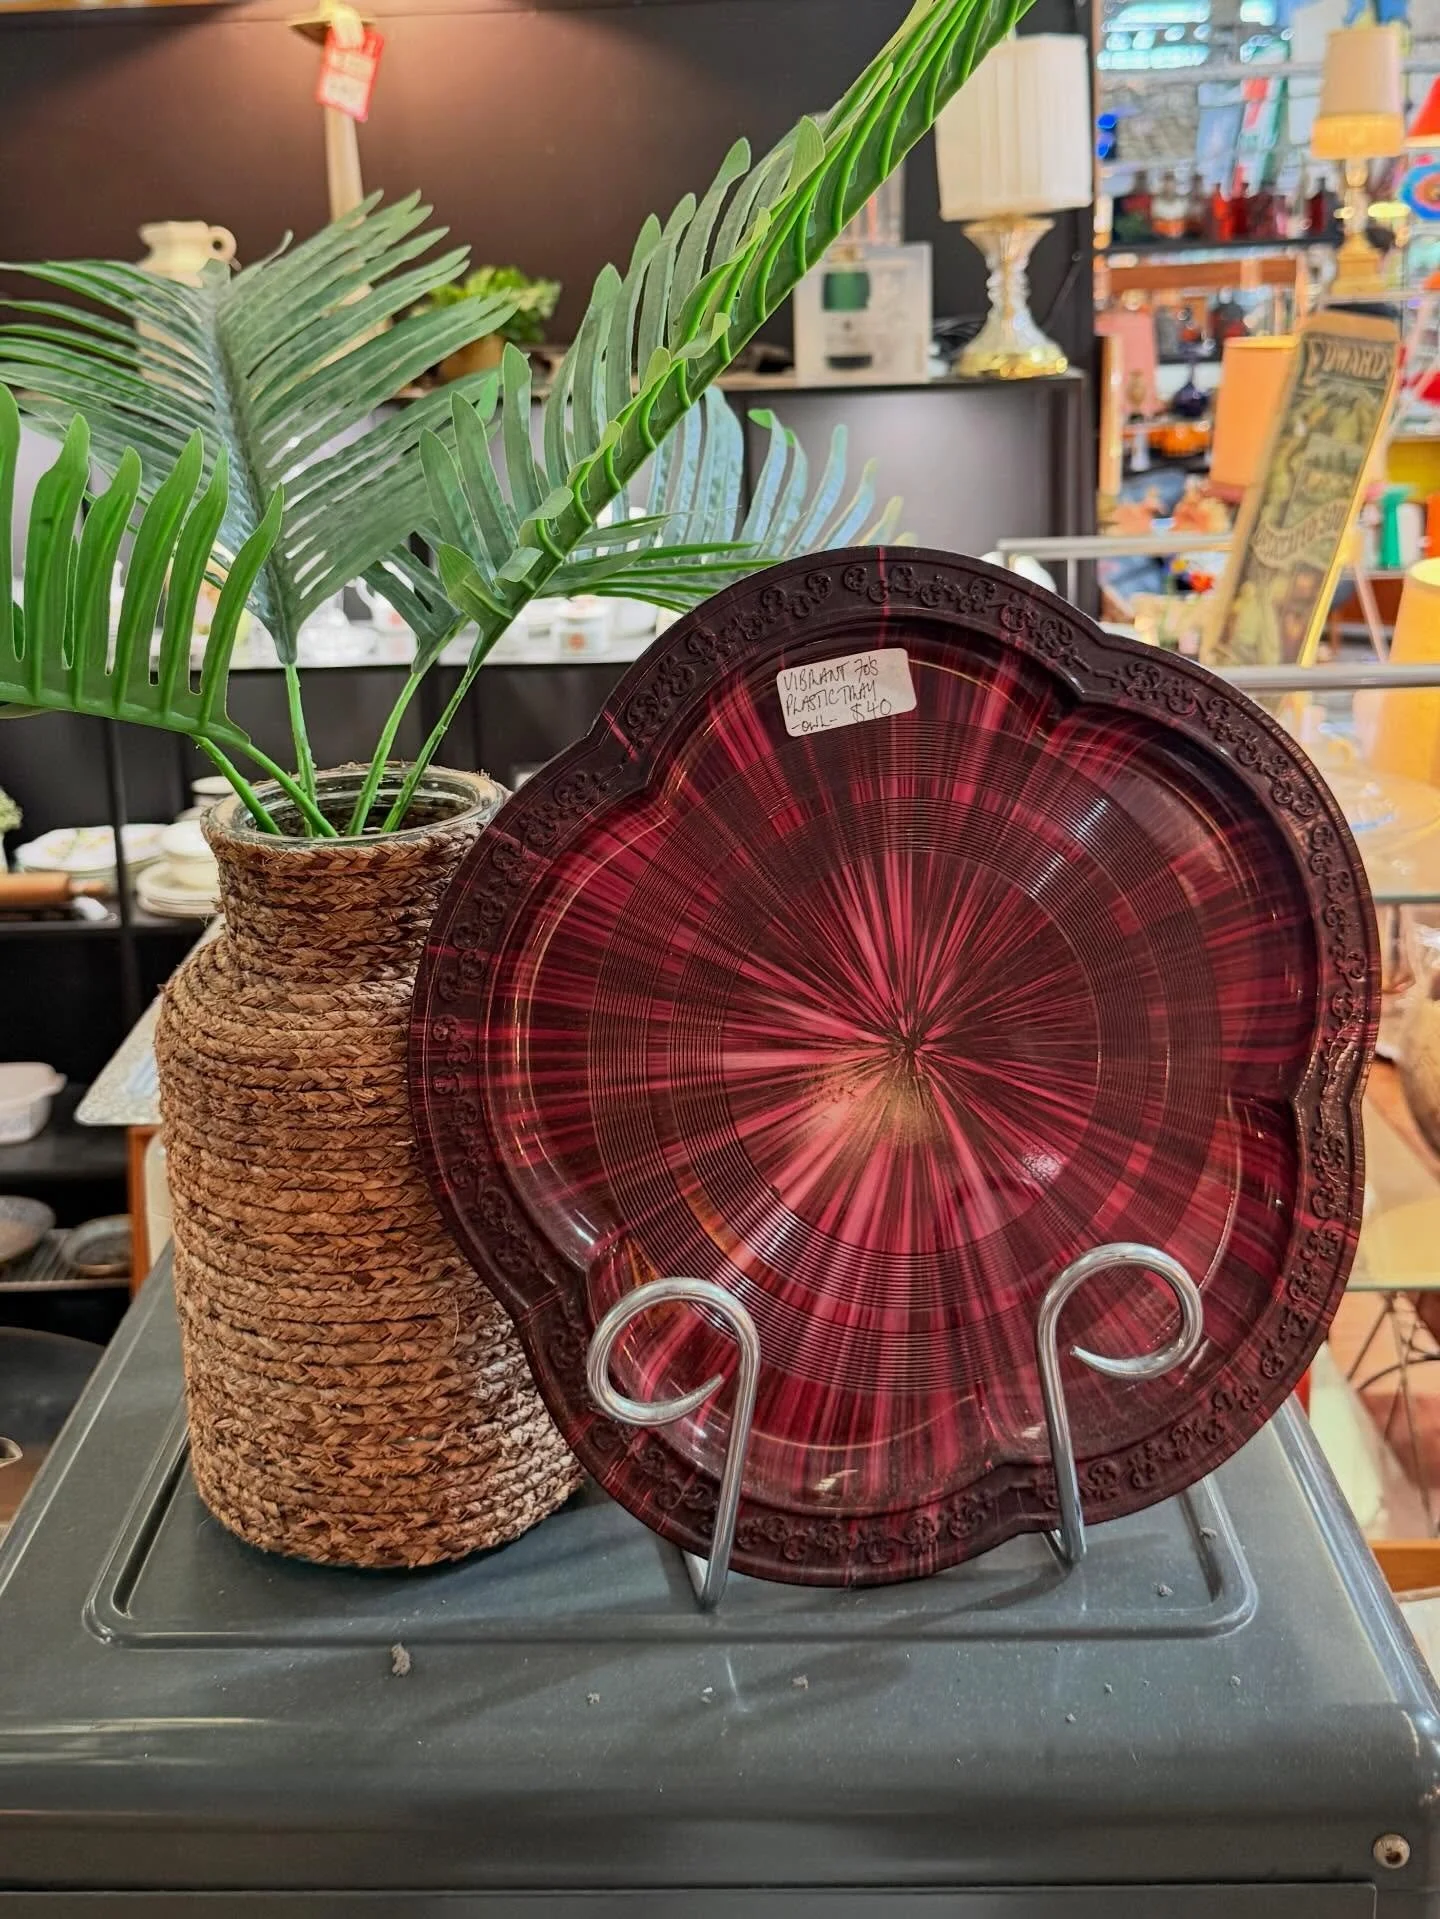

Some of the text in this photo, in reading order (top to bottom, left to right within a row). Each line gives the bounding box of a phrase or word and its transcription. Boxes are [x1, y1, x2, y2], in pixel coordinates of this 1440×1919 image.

[784, 661, 849, 691] VIBRANT
[786, 680, 877, 716] PLASTIC TRAY
[850, 698, 892, 722] $40
